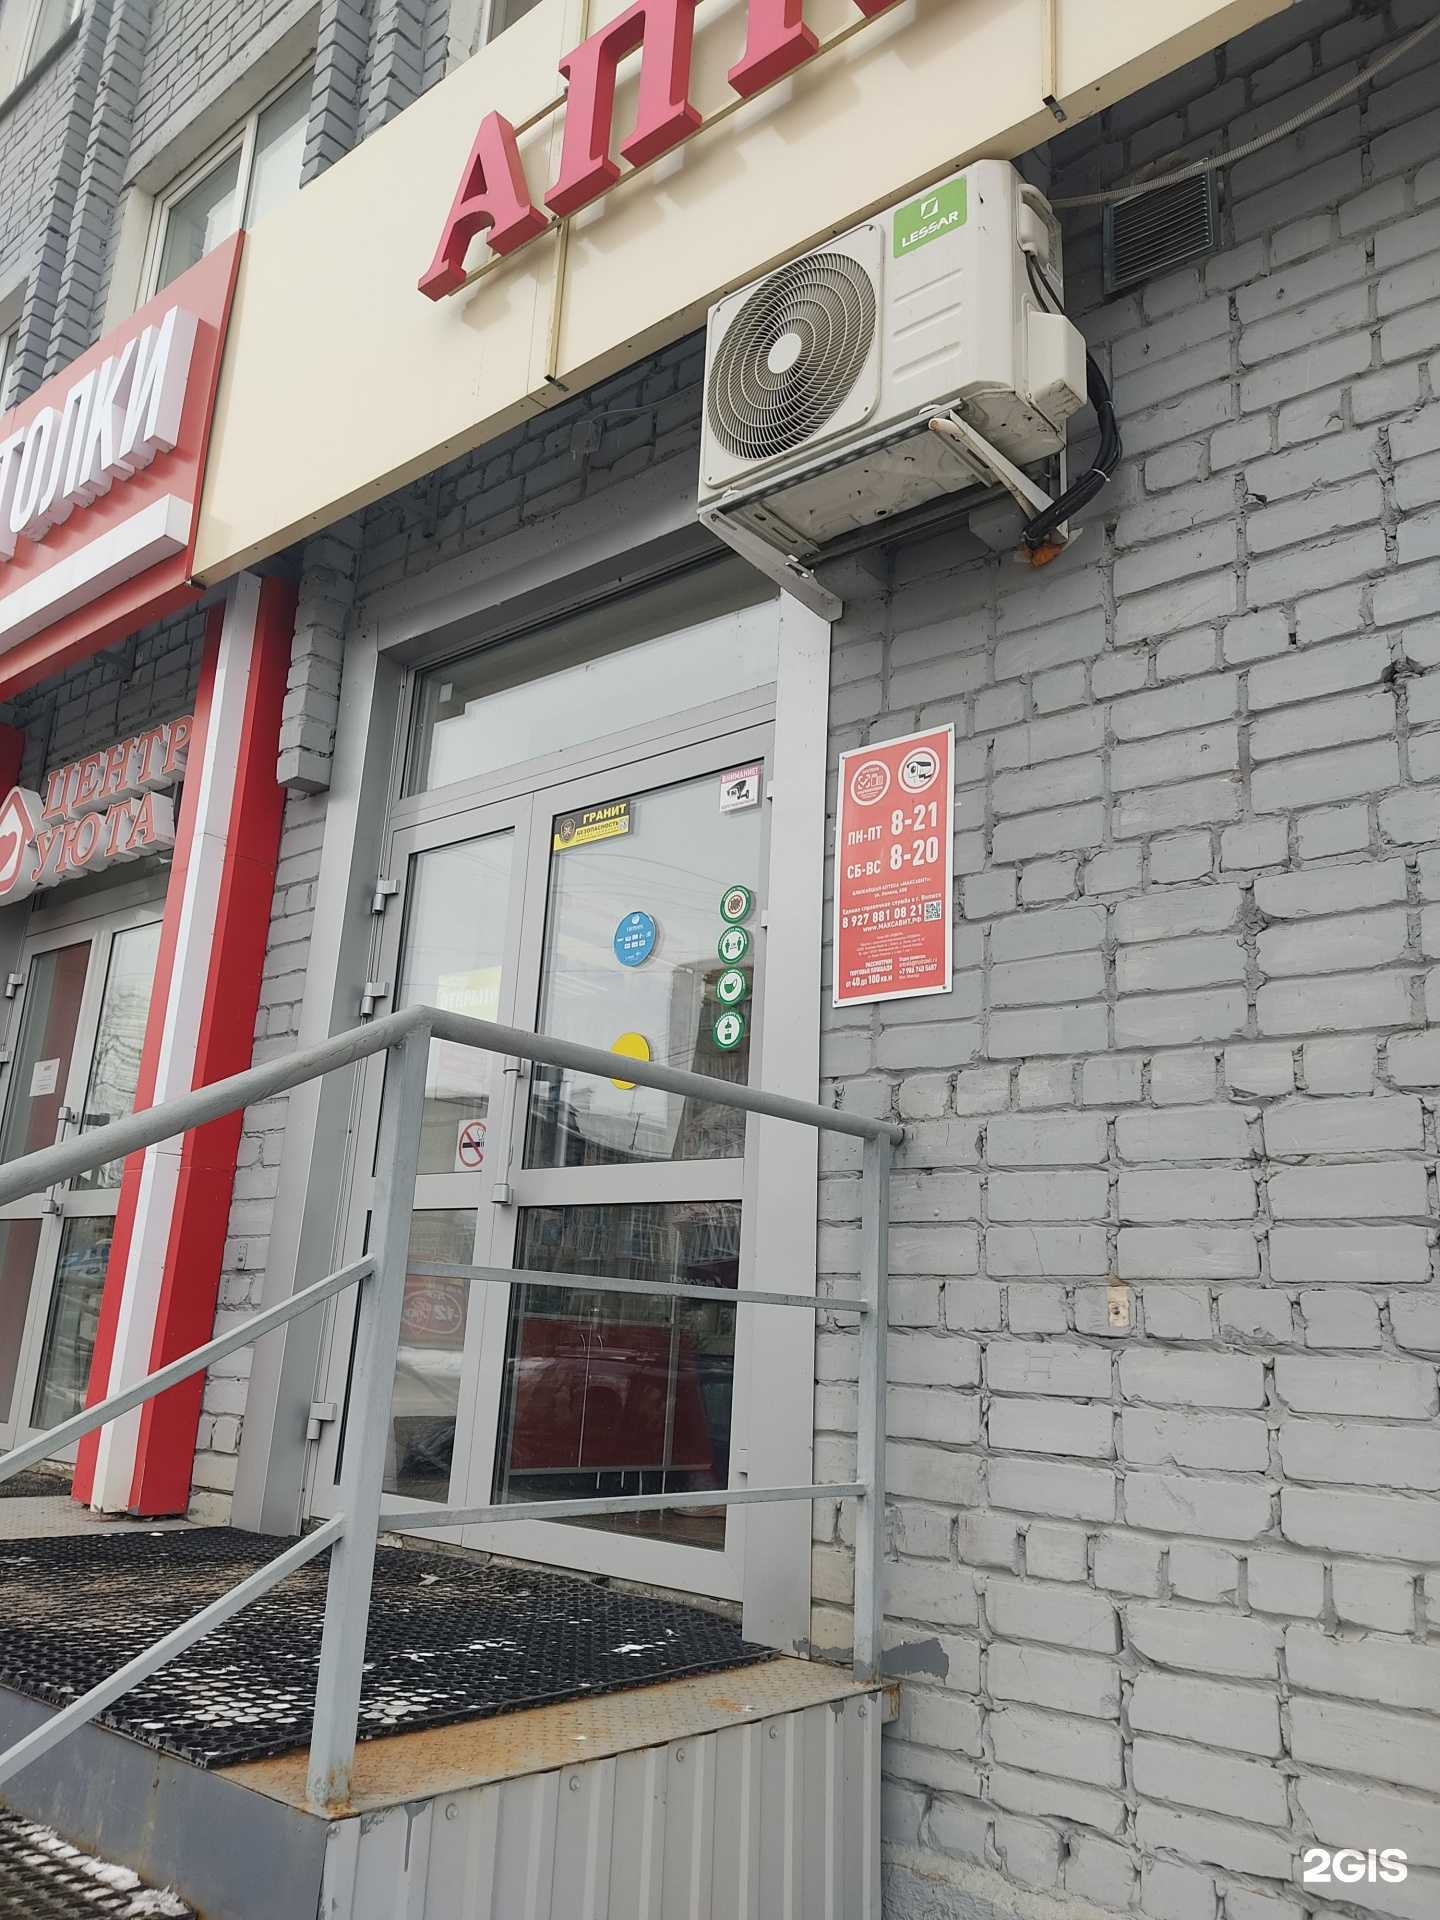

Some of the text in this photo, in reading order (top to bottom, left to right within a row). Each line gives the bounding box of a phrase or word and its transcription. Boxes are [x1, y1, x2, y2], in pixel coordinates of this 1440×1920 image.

[418, 0, 905, 302] АП
[901, 210, 959, 248] LESSAR
[41, 714, 194, 820] ЦЕНТР
[583, 803, 627, 824] ГРАНИТ
[891, 801, 938, 836] 8-21
[31, 792, 158, 881] УЮТА
[847, 825, 882, 845] ПН-ПТ
[847, 861, 881, 879] СБ-ВС
[890, 836, 939, 870] 8-20
[842, 918, 849, 929] 8
[852, 913, 869, 927] 927
[894, 906, 907, 920] 08
[910, 903, 922, 917] 21
[868, 974, 881, 984] 100
